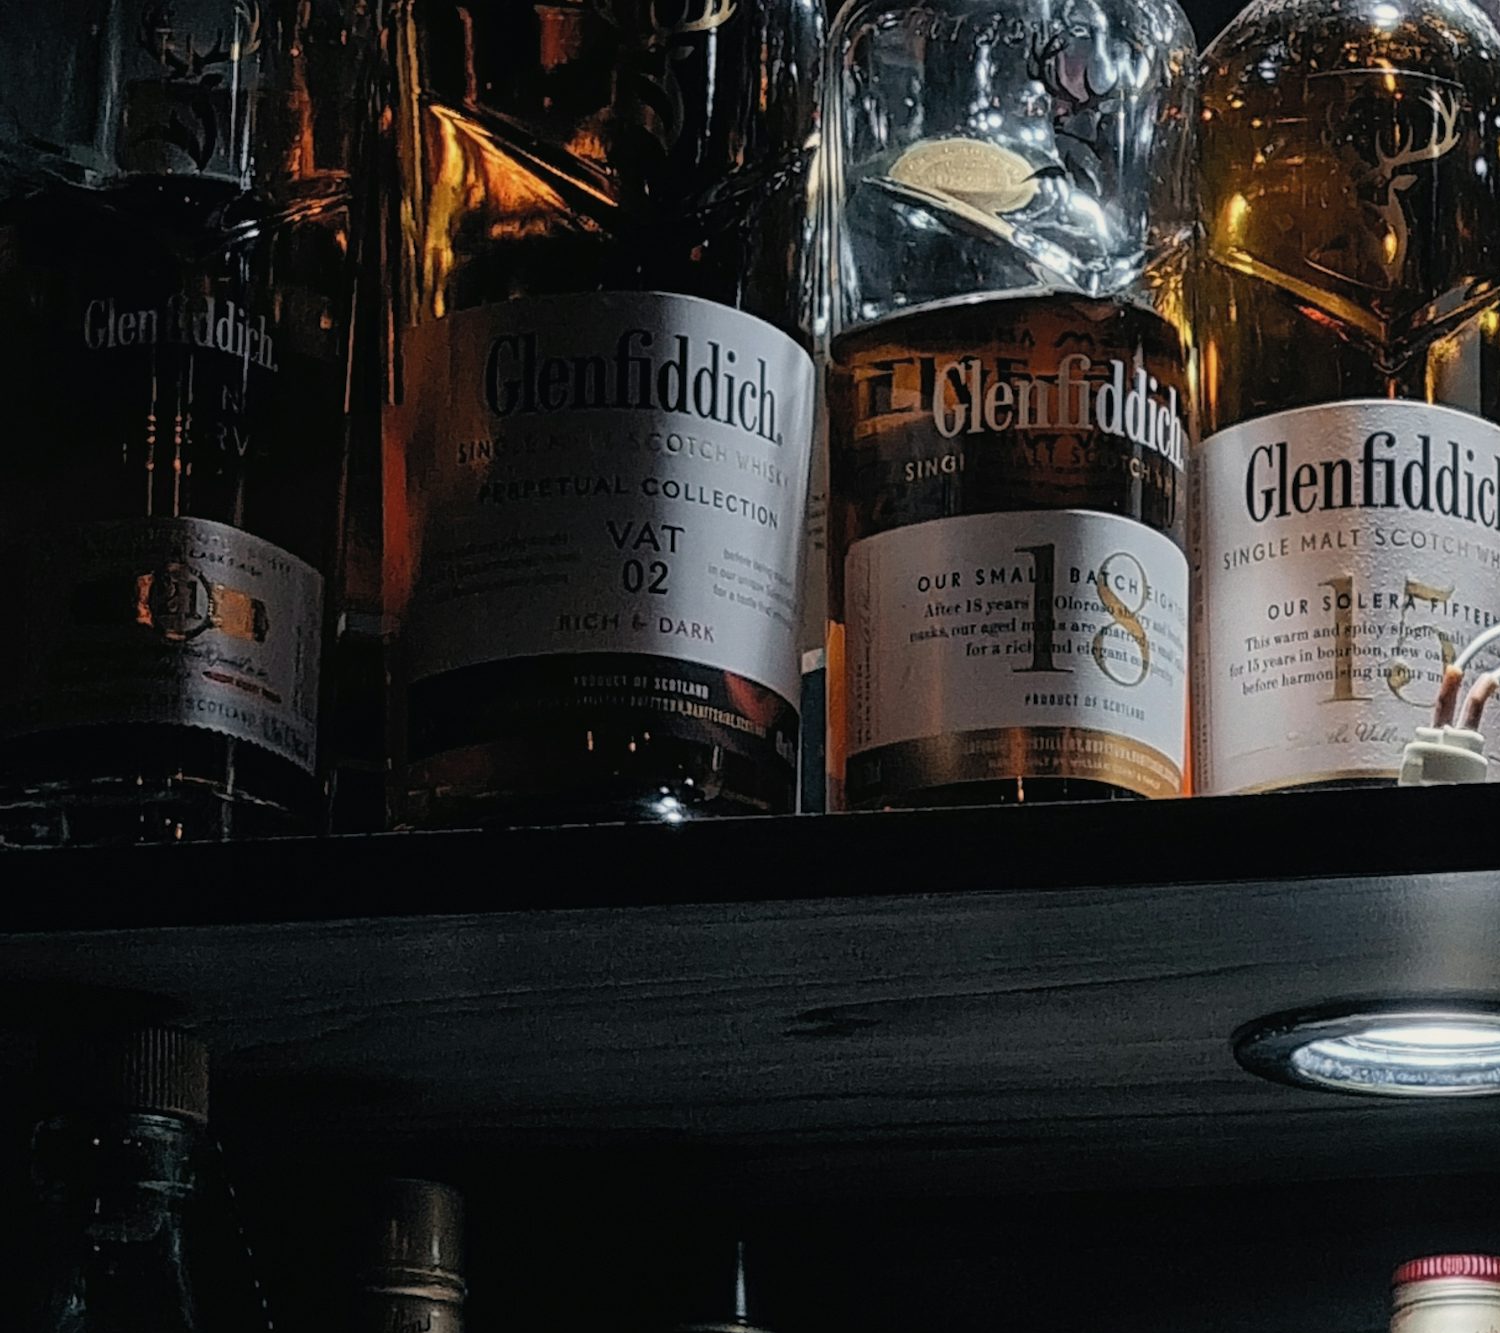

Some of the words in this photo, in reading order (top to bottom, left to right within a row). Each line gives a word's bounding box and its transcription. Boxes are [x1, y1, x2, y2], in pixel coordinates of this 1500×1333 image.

[484, 329, 782, 447] Glenfiddich
[932, 353, 1184, 471] Glenfiddich
[641, 478, 780, 530] COLLECTION
[606, 520, 685, 553] VAT
[1223, 537, 1290, 571] SINGLE
[1300, 528, 1360, 553] MALT
[1374, 527, 1470, 558] SCOTCH
[622, 559, 669, 595] 02
[917, 572, 961, 593] OUR
[1070, 566, 1139, 594] BATCH
[986, 597, 1029, 616] years
[1055, 595, 1114, 615] Oloroso
[1013, 543, 1151, 687] 18
[1268, 599, 1308, 621] OUR
[1323, 592, 1417, 613] SOLERA
[559, 612, 619, 632] RICH
[659, 617, 715, 642] DARK
[951, 624, 976, 638] our
[981, 617, 1016, 641] aged
[1070, 621, 1096, 634] are
[1245, 635, 1271, 653] This
[1274, 628, 1308, 646] warm
[1313, 622, 1340, 639] and
[1345, 619, 1385, 642] spicy
[1316, 575, 1458, 708] 15
[966, 643, 988, 657] for
[990, 645, 1001, 656] a
[1247, 659, 1260, 674] 15
[1262, 653, 1297, 672] years
[1300, 648, 1313, 662] in
[1317, 644, 1389, 660] bourbon,
[1242, 677, 1278, 697] before
[1282, 666, 1372, 689] harmonising
[1377, 666, 1393, 680] in
[1025, 692, 1079, 706] PRODUCT
